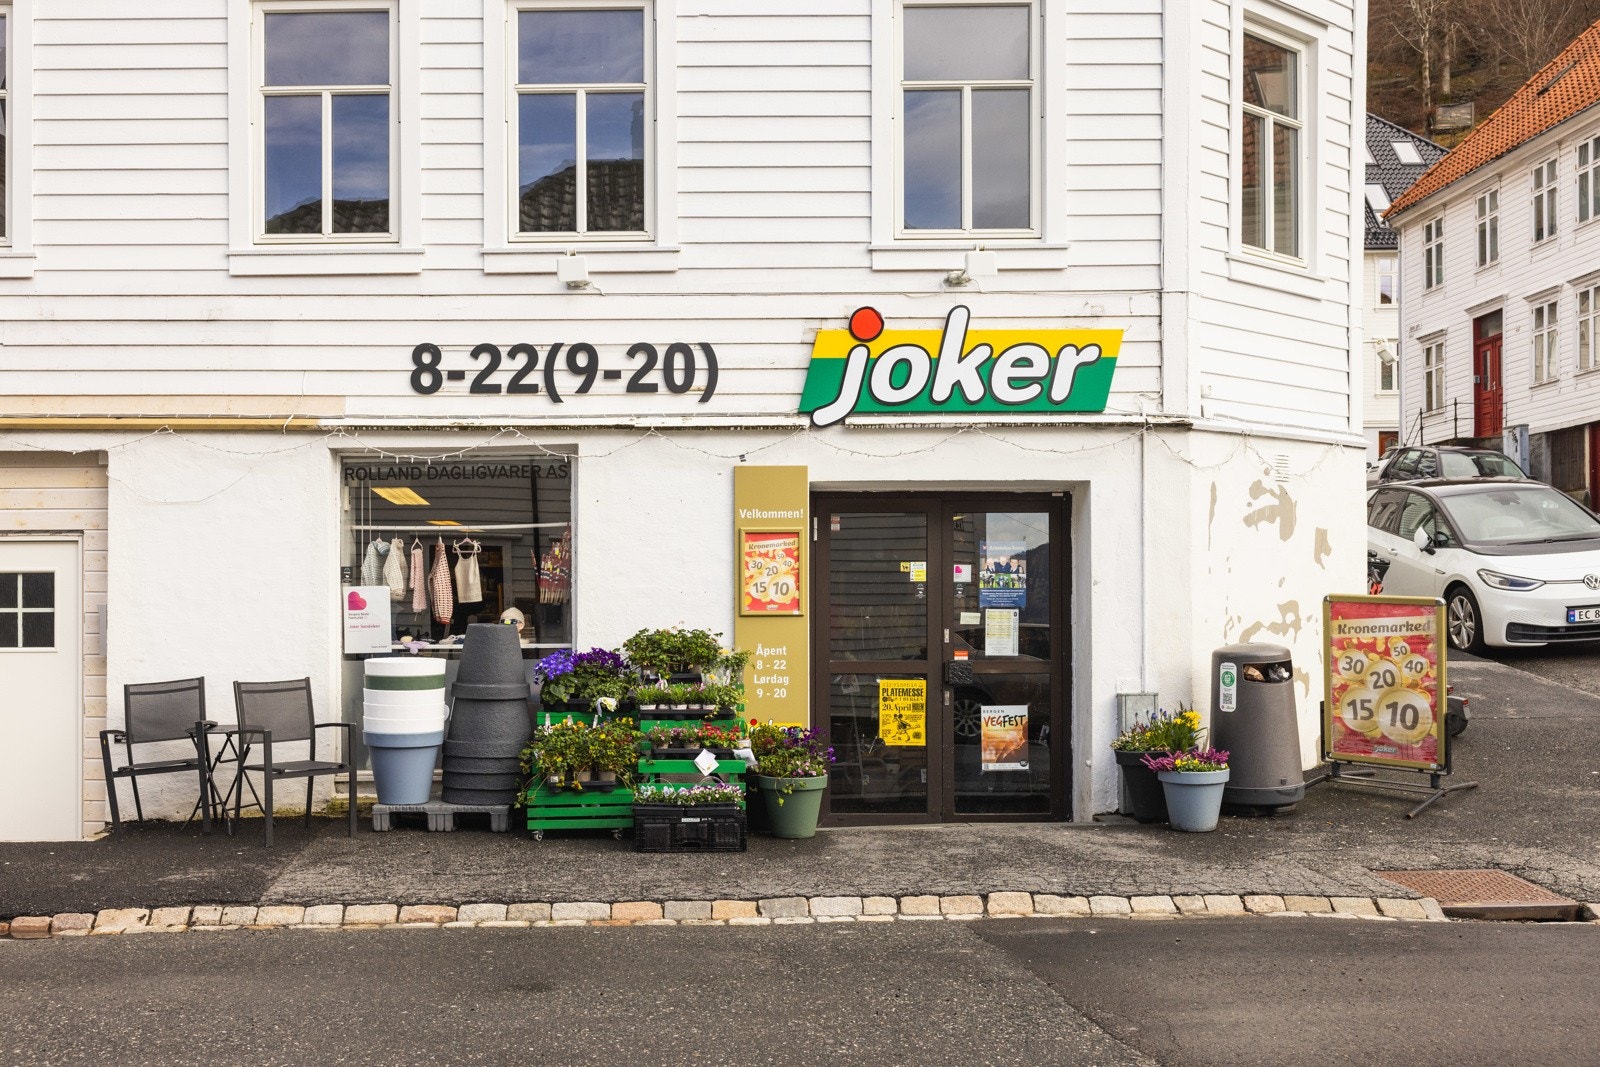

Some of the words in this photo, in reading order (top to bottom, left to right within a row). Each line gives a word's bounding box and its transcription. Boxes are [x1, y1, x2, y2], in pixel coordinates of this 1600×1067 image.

[811, 305, 1103, 427] joker
[410, 342, 718, 403] 8-22(9-20)
[344, 466, 421, 481] ROLLAND
[427, 465, 541, 480] DAGLIGVARER
[546, 464, 569, 479] AS
[739, 508, 804, 519] Velkommen!
[748, 540, 796, 550] Kronemarked
[751, 560, 763, 570] 30
[765, 565, 779, 577] 20
[753, 582, 767, 594] 15
[773, 581, 790, 596] 10
[1578, 610, 1591, 619] EC
[1337, 620, 1431, 635] Kronemarked
[756, 643, 787, 657] Åpent
[1393, 645, 1408, 657] 50
[756, 660, 763, 670] 8
[773, 660, 787, 670] 22
[1342, 656, 1365, 675] 30
[1404, 660, 1424, 674] 40
[753, 674, 789, 685] Lørdag
[1369, 669, 1396, 690] 20
[756, 688, 763, 698] 9
[773, 688, 787, 698] 20
[882, 688, 924, 697] PLATEMESSE
[895, 703, 912, 713] April
[1346, 698, 1375, 721] 15
[983, 715, 1026, 728] VEGFEST
[1385, 701, 1420, 731] 10
